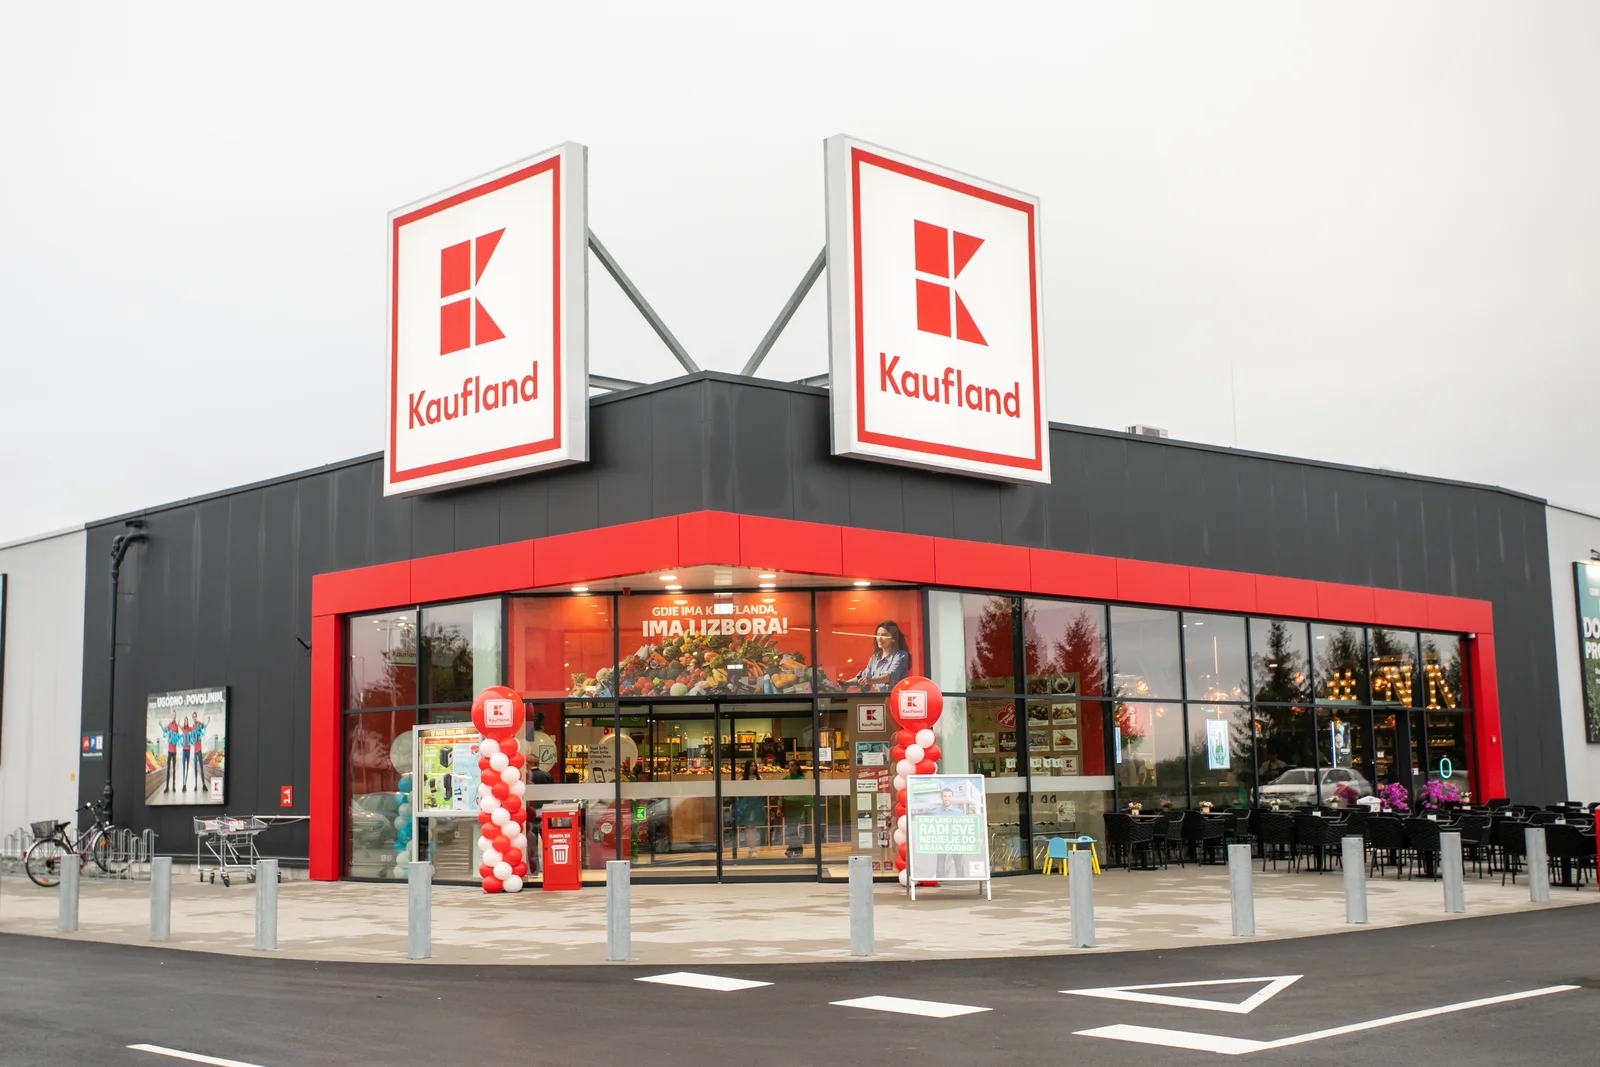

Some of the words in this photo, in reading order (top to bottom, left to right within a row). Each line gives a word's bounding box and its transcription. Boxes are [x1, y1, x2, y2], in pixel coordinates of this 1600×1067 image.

[879, 351, 1022, 419] Kaufland
[407, 360, 539, 430] Kaufland
[652, 606, 679, 616] GDJE
[681, 605, 703, 616] IMA
[706, 604, 778, 616] KFLANDA,
[642, 619, 684, 637] IMA
[689, 619, 696, 636] I
[700, 617, 788, 636] IZBORA!
[919, 824, 949, 835] RADI
[952, 824, 976, 835] SVE
[919, 835, 960, 844] NEDJELJE
[962, 835, 976, 844] DO
